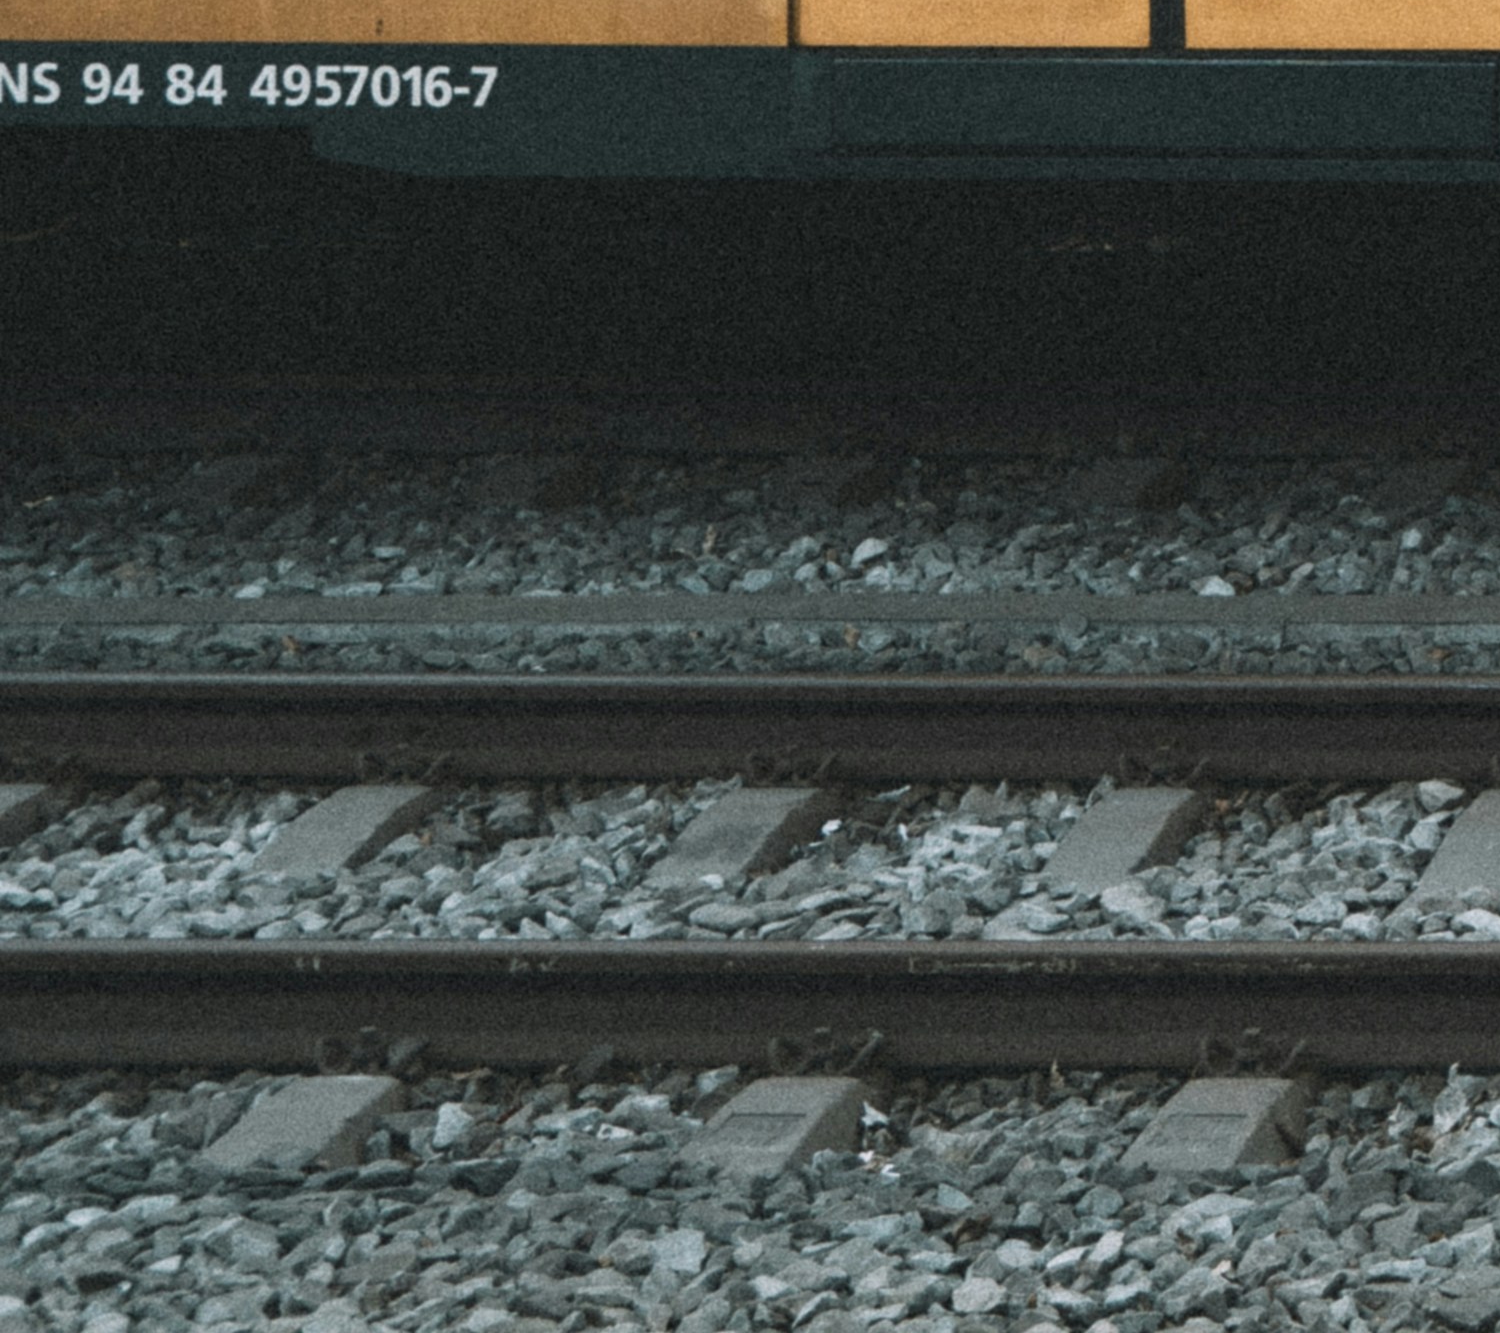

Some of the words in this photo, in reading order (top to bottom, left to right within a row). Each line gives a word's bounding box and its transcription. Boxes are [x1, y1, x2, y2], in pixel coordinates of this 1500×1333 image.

[0, 62, 61, 105] NS
[82, 62, 144, 105] 94
[165, 63, 228, 106] 84
[250, 64, 498, 107] 4957016-7
